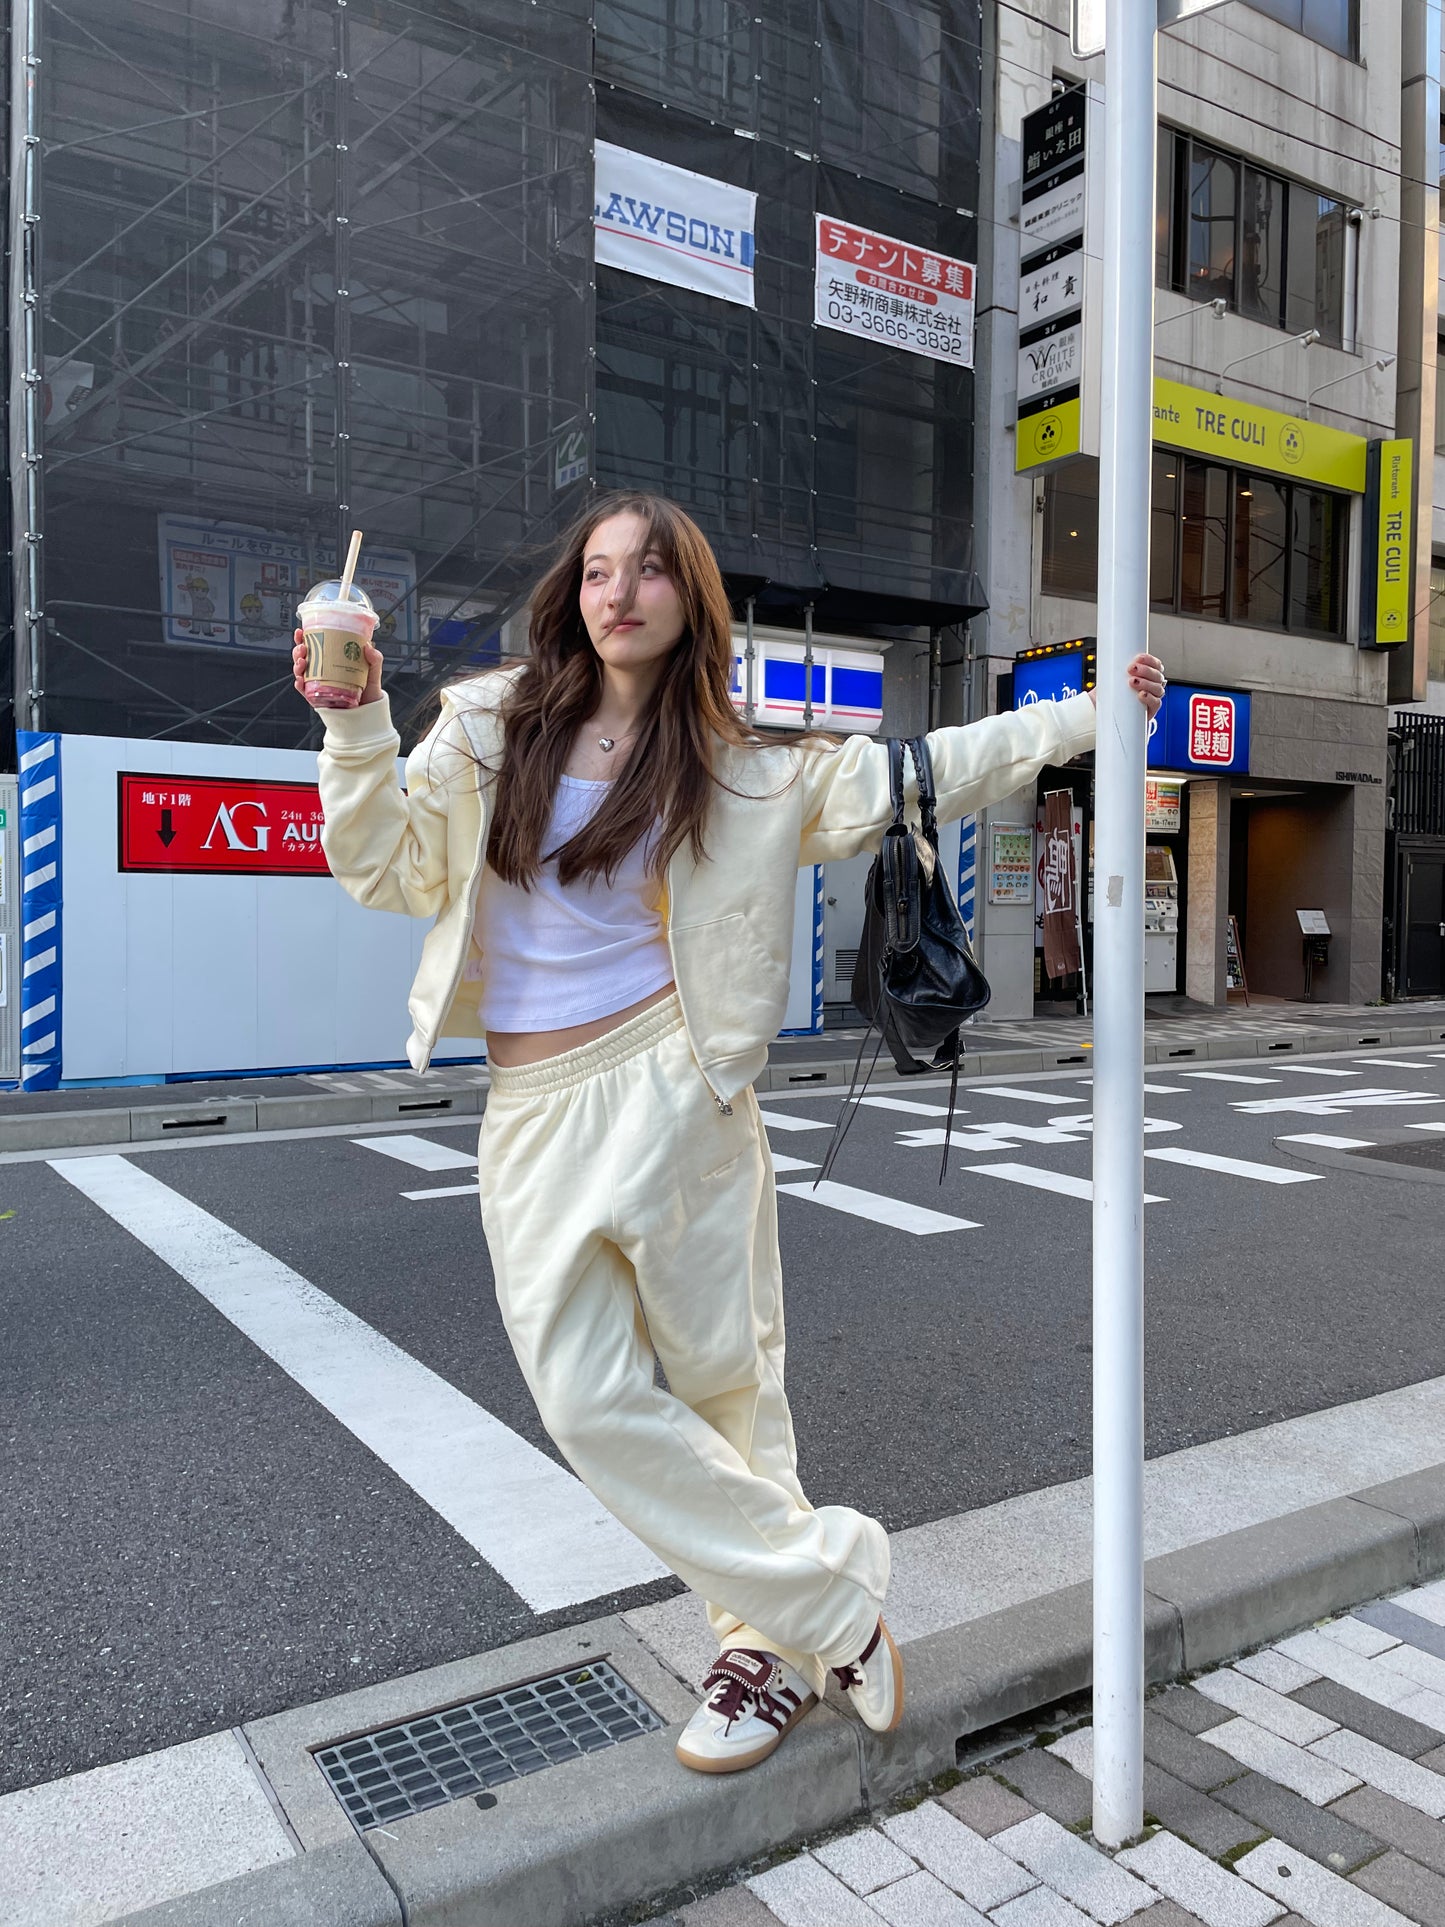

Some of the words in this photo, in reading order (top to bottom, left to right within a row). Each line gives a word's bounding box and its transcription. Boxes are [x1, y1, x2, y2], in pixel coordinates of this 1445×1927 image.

[828, 227, 965, 296] テナント募集
[828, 278, 962, 336] 矢野新商事株式会社
[828, 300, 963, 356] 03-3666-3832
[1044, 323, 1057, 335] 3F
[1031, 358, 1073, 384] CROWN
[1043, 397, 1056, 409] 2F
[1195, 407, 1227, 436] TRE
[1231, 418, 1266, 447] CULI
[1391, 455, 1401, 499] Ristorante
[1386, 510, 1402, 542] TRE
[1385, 546, 1400, 582] CULI
[1195, 702, 1231, 731] 自家
[1193, 729, 1230, 758] 製麺
[141, 791, 192, 807] 地下1階
[200, 800, 272, 852] AG
[280, 810, 303, 821] 24H
